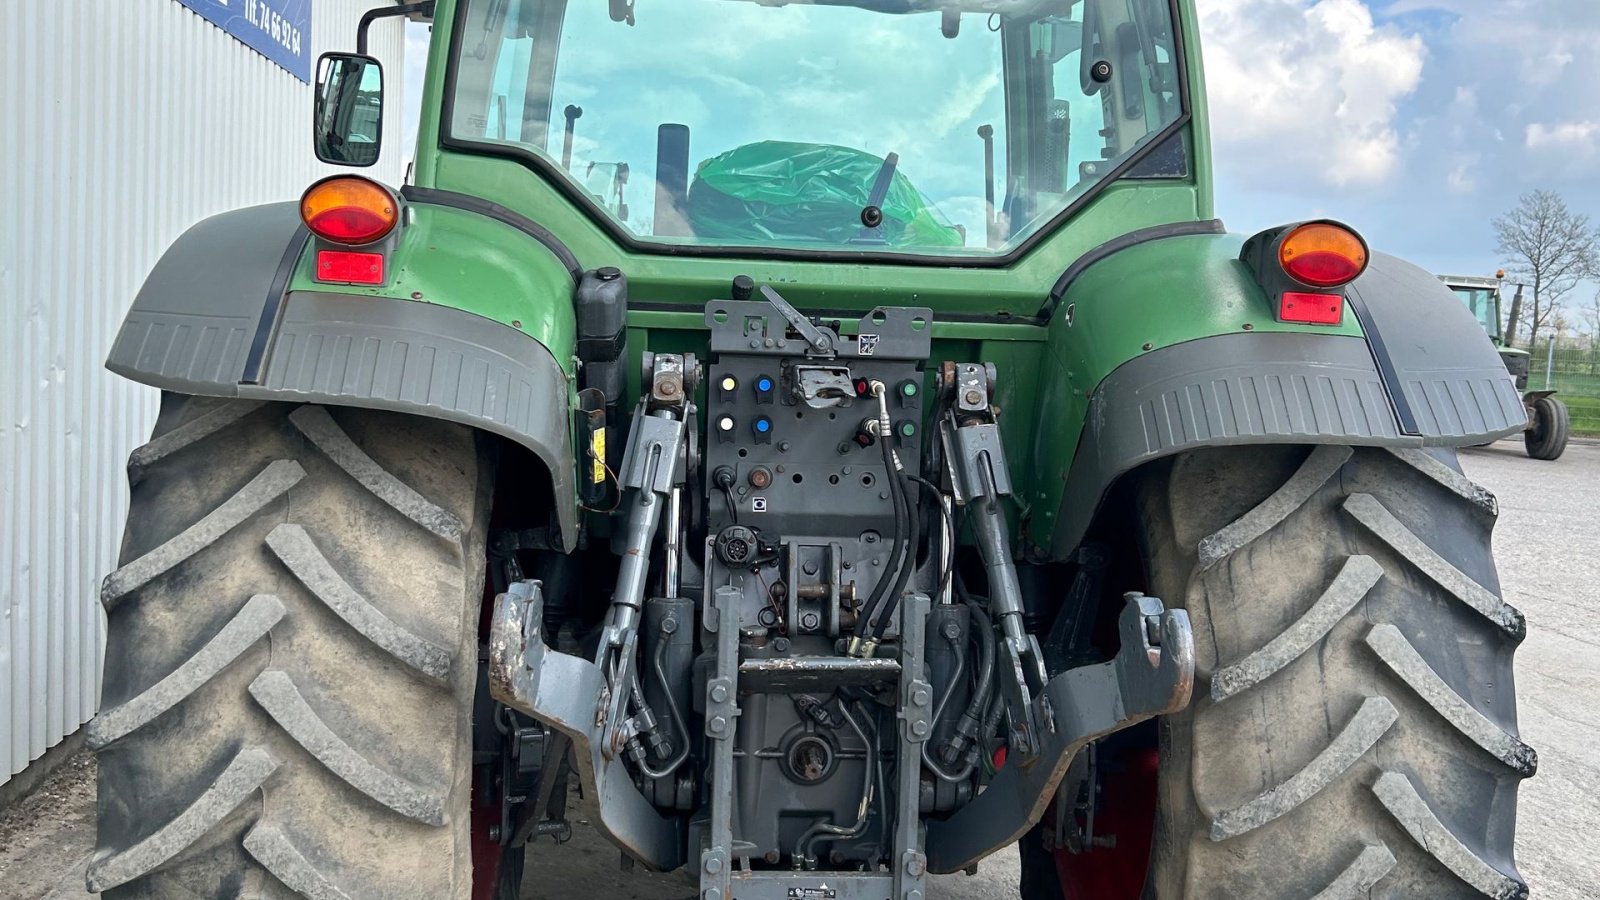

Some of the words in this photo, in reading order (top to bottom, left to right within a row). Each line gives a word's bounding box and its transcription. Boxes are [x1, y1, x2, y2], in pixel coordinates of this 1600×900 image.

[260, 1, 270, 34] 74
[271, 11, 281, 42] 66
[282, 19, 291, 50] 92
[292, 28, 301, 56] 64
